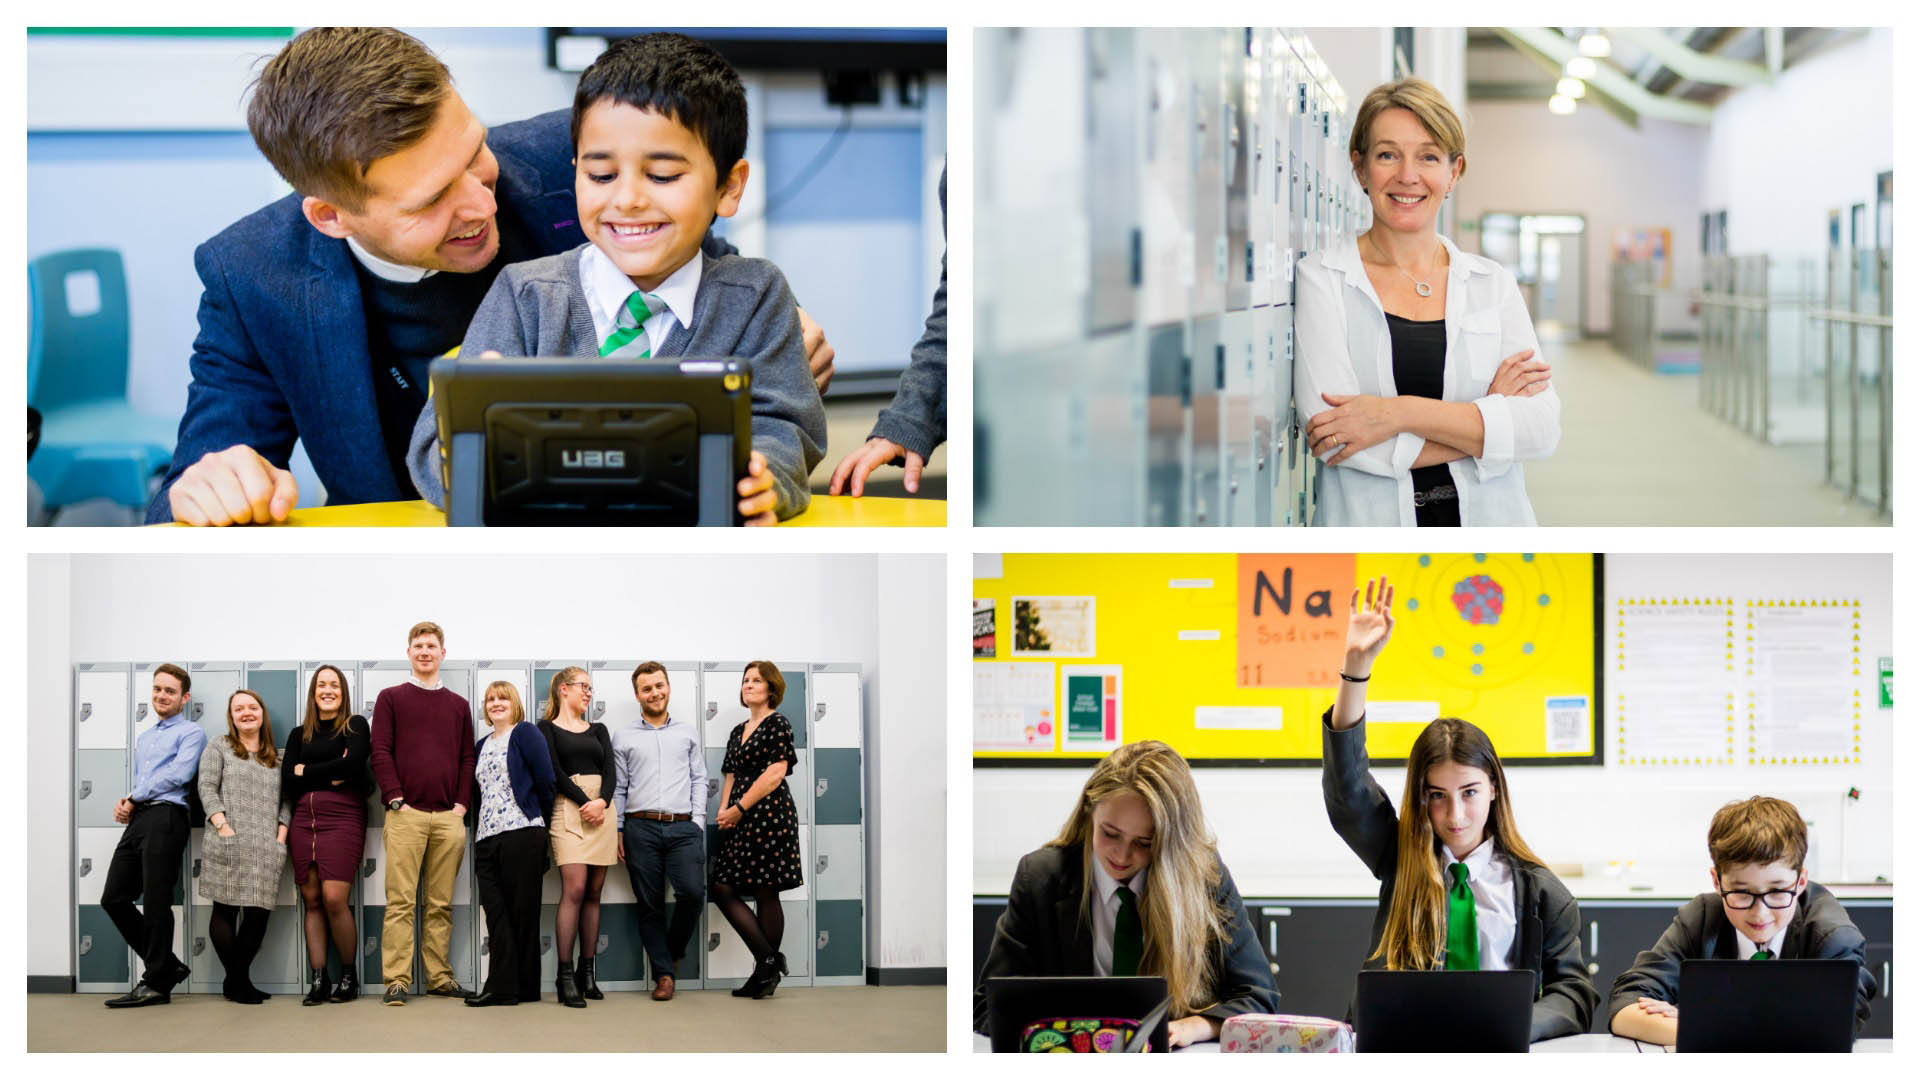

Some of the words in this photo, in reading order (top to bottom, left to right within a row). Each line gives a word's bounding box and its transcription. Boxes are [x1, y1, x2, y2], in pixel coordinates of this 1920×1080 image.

[389, 367, 409, 389] STAFF
[1253, 566, 1332, 617] Na
[1258, 624, 1339, 645] Sodium
[1242, 664, 1264, 685] 11
